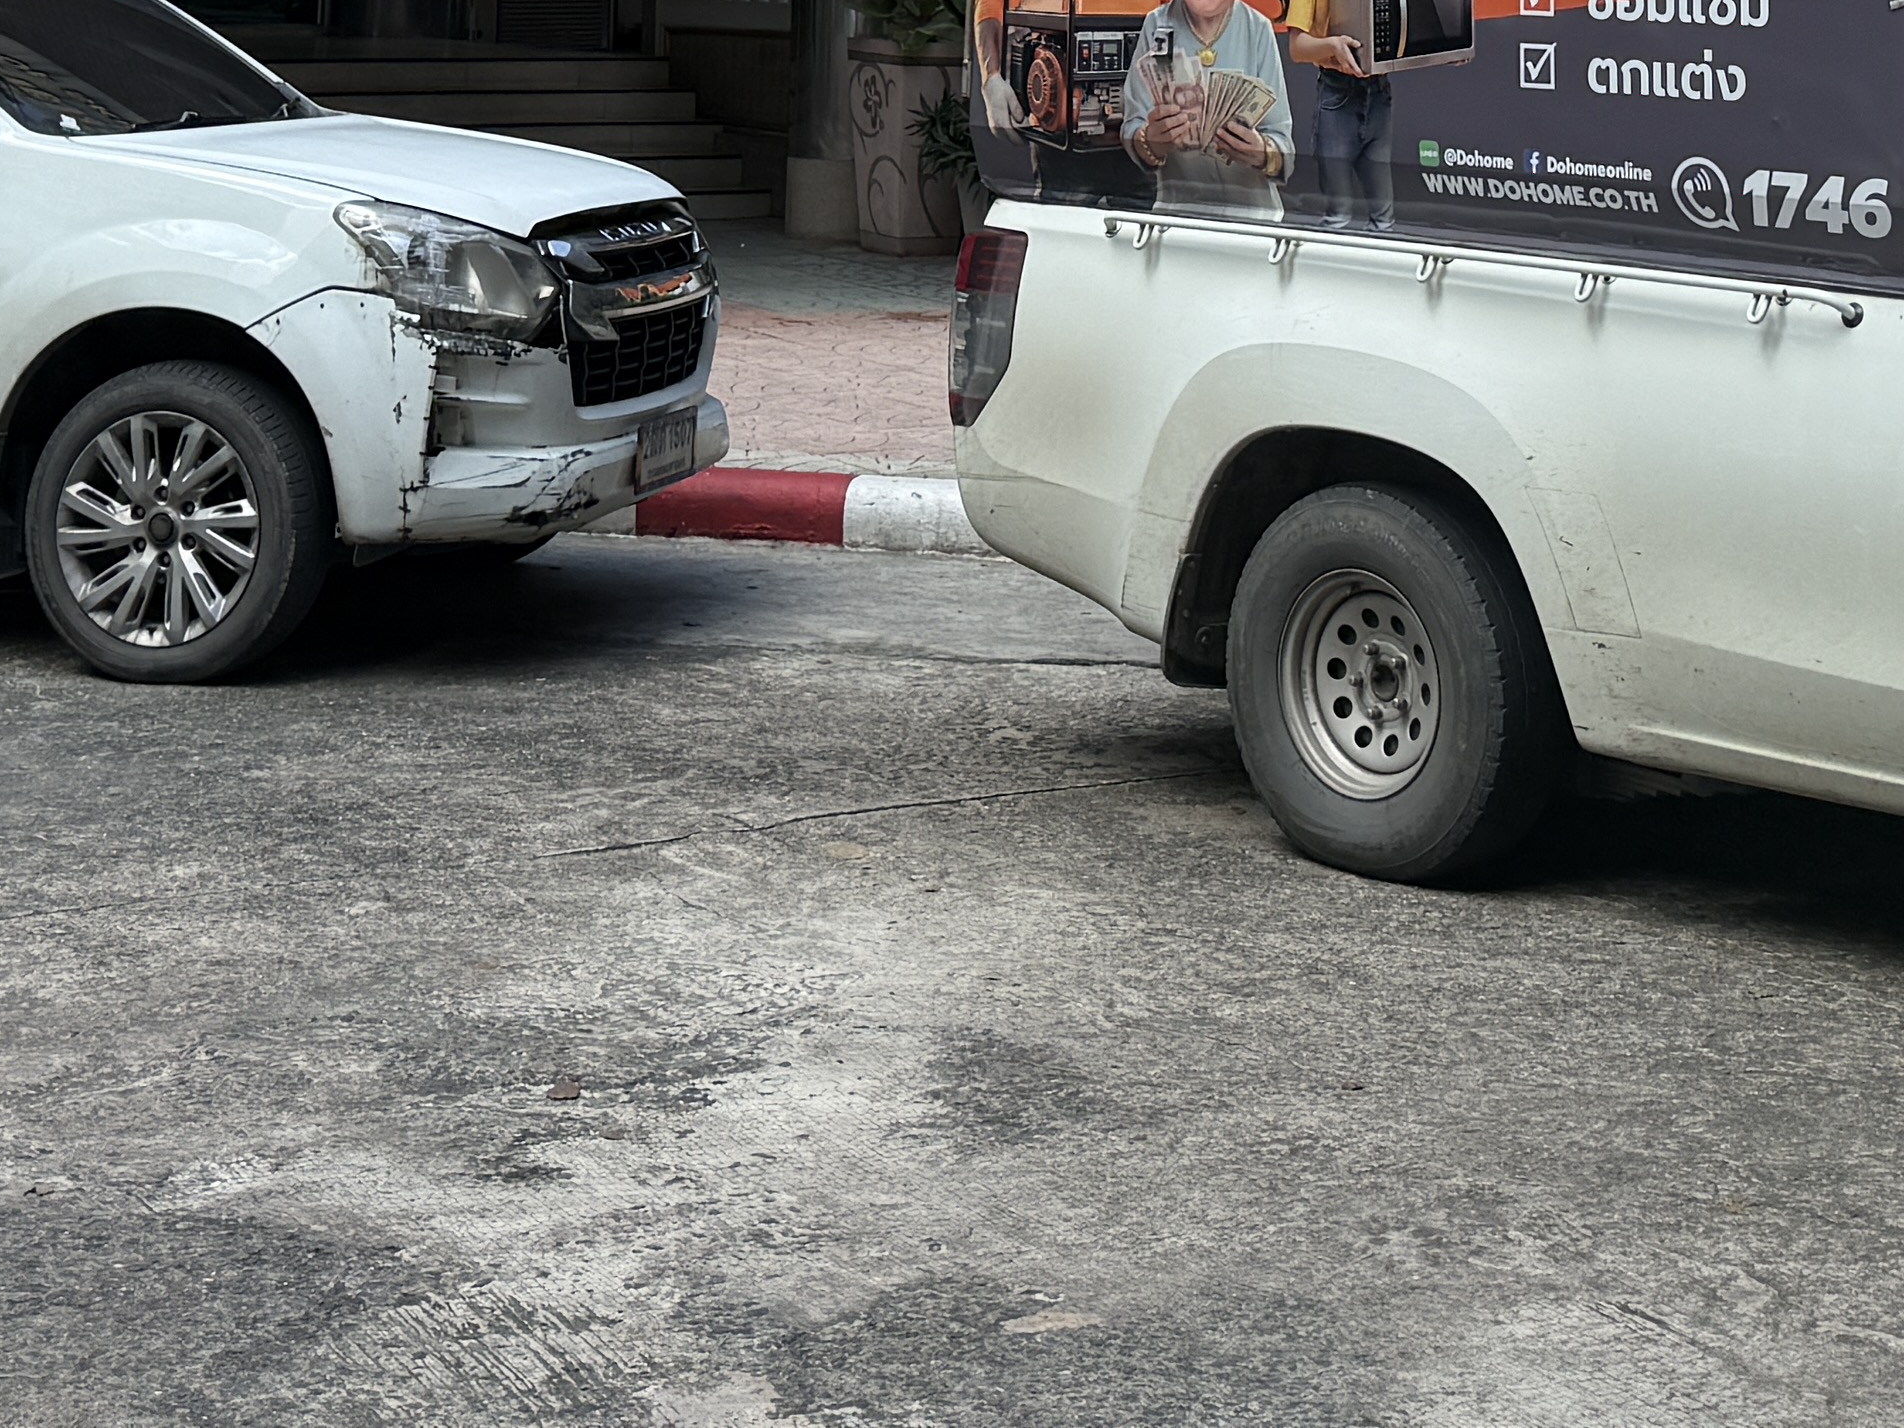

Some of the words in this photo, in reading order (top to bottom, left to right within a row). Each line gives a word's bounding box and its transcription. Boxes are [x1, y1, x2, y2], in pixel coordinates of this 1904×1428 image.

[1586, 50, 1748, 104] ตกแต่ง
[1443, 147, 1514, 171] @Dohome
[1546, 156, 1653, 182] Dohomeonline
[1421, 172, 1659, 214] WWW.DOHOME.CO.TH
[1740, 168, 1892, 240] 1746
